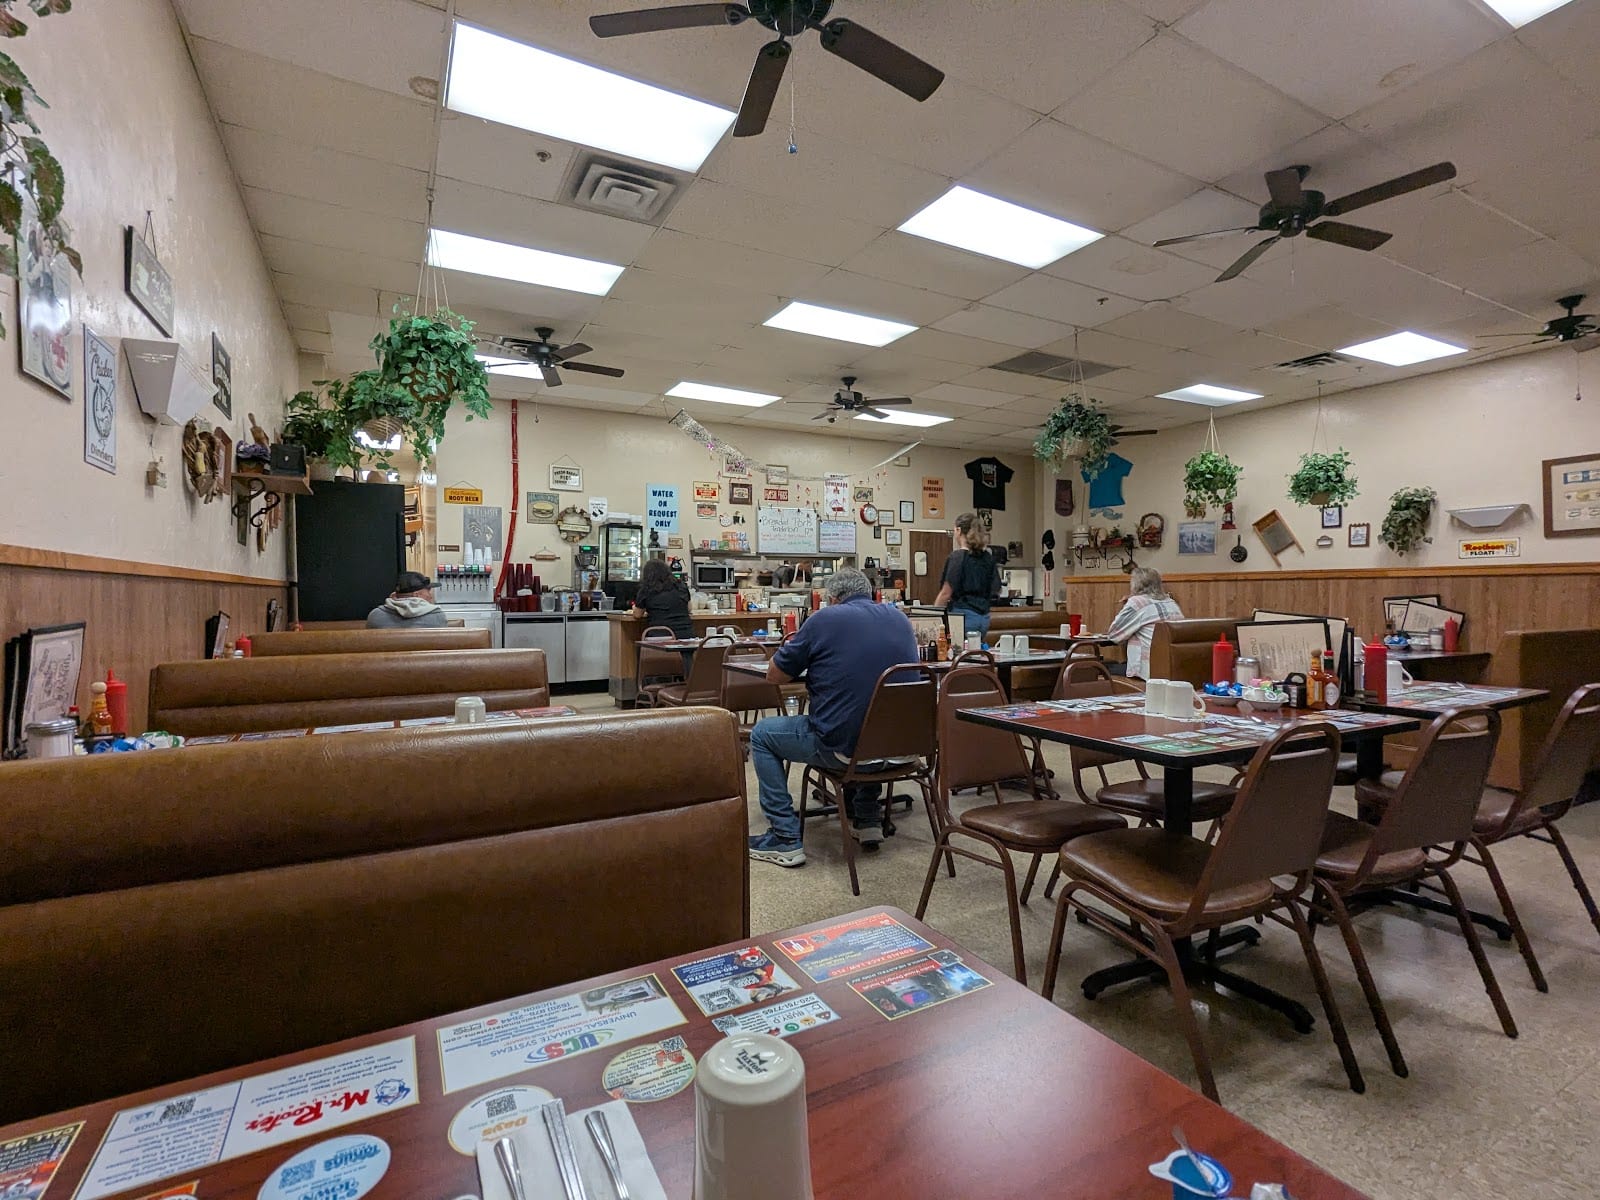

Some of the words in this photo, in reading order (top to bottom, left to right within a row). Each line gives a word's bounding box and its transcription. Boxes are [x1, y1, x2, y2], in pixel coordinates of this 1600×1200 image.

[652, 490, 674, 498] WATER
[658, 500, 668, 508] ON
[648, 510, 677, 518] REQUEST
[654, 520, 672, 528] ONLY
[583, 1010, 637, 1030] UNIVERSAL
[539, 1026, 583, 1043] CLIMATE
[489, 1038, 537, 1057] SYSTEMS
[542, 1031, 599, 1060] UCS
